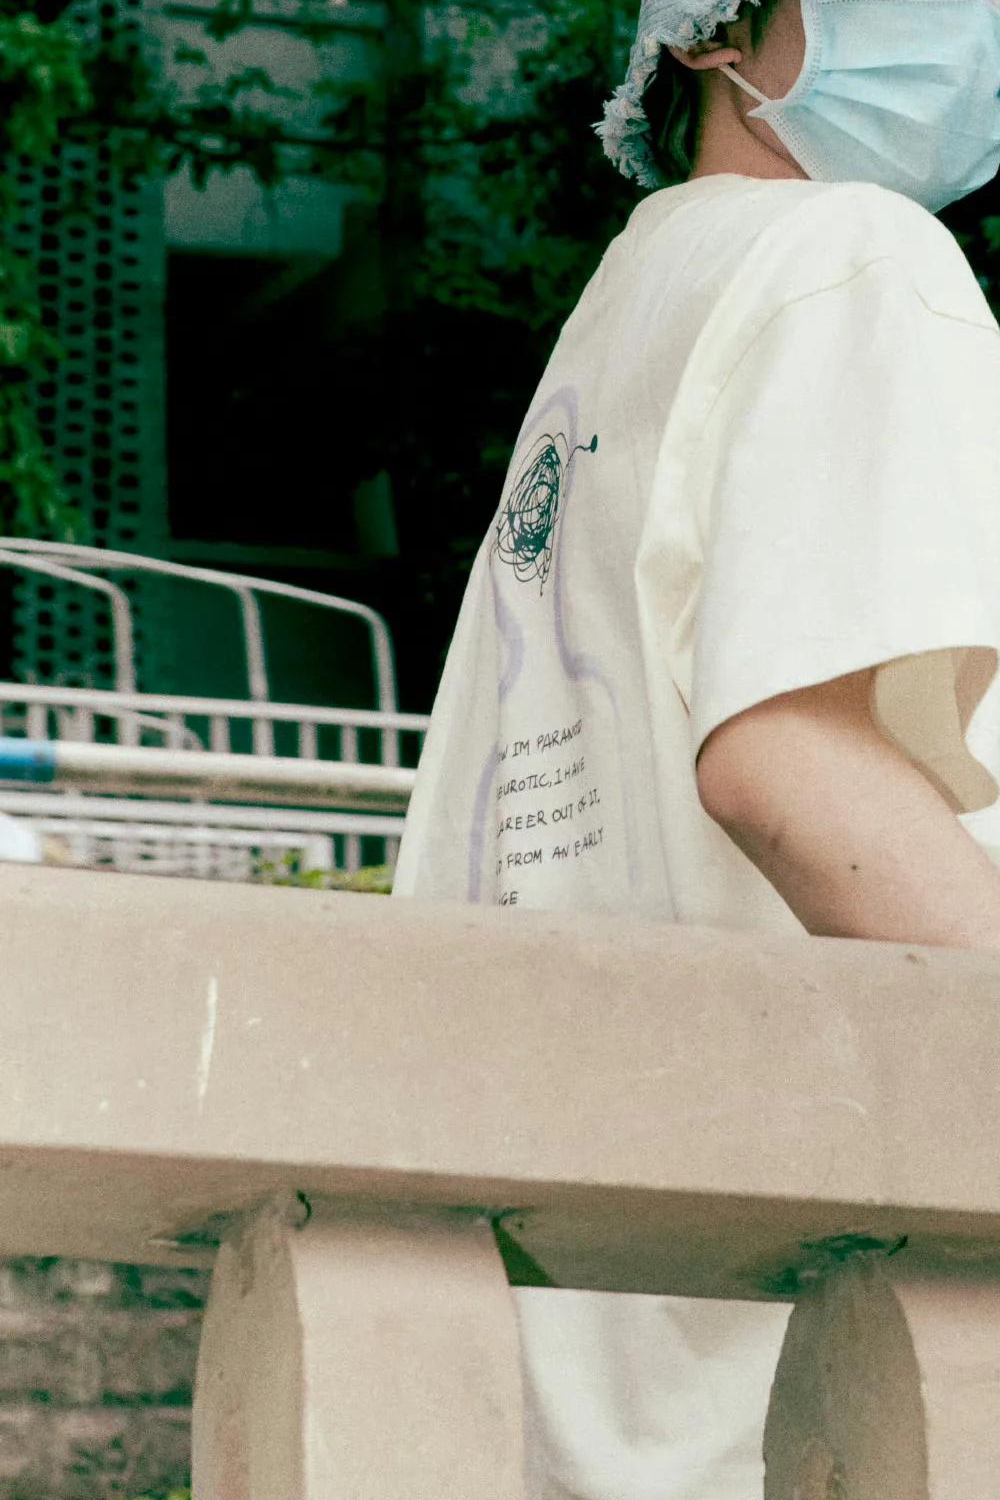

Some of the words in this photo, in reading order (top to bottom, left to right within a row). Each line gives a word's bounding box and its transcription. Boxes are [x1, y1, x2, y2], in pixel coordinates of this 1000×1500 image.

[555, 768, 562, 785] I
[564, 756, 585, 780] HAVE
[552, 803, 573, 822] OUT
[507, 848, 542, 868] FROM
[552, 845, 569, 860] AN
[574, 827, 603, 857] EARLY
